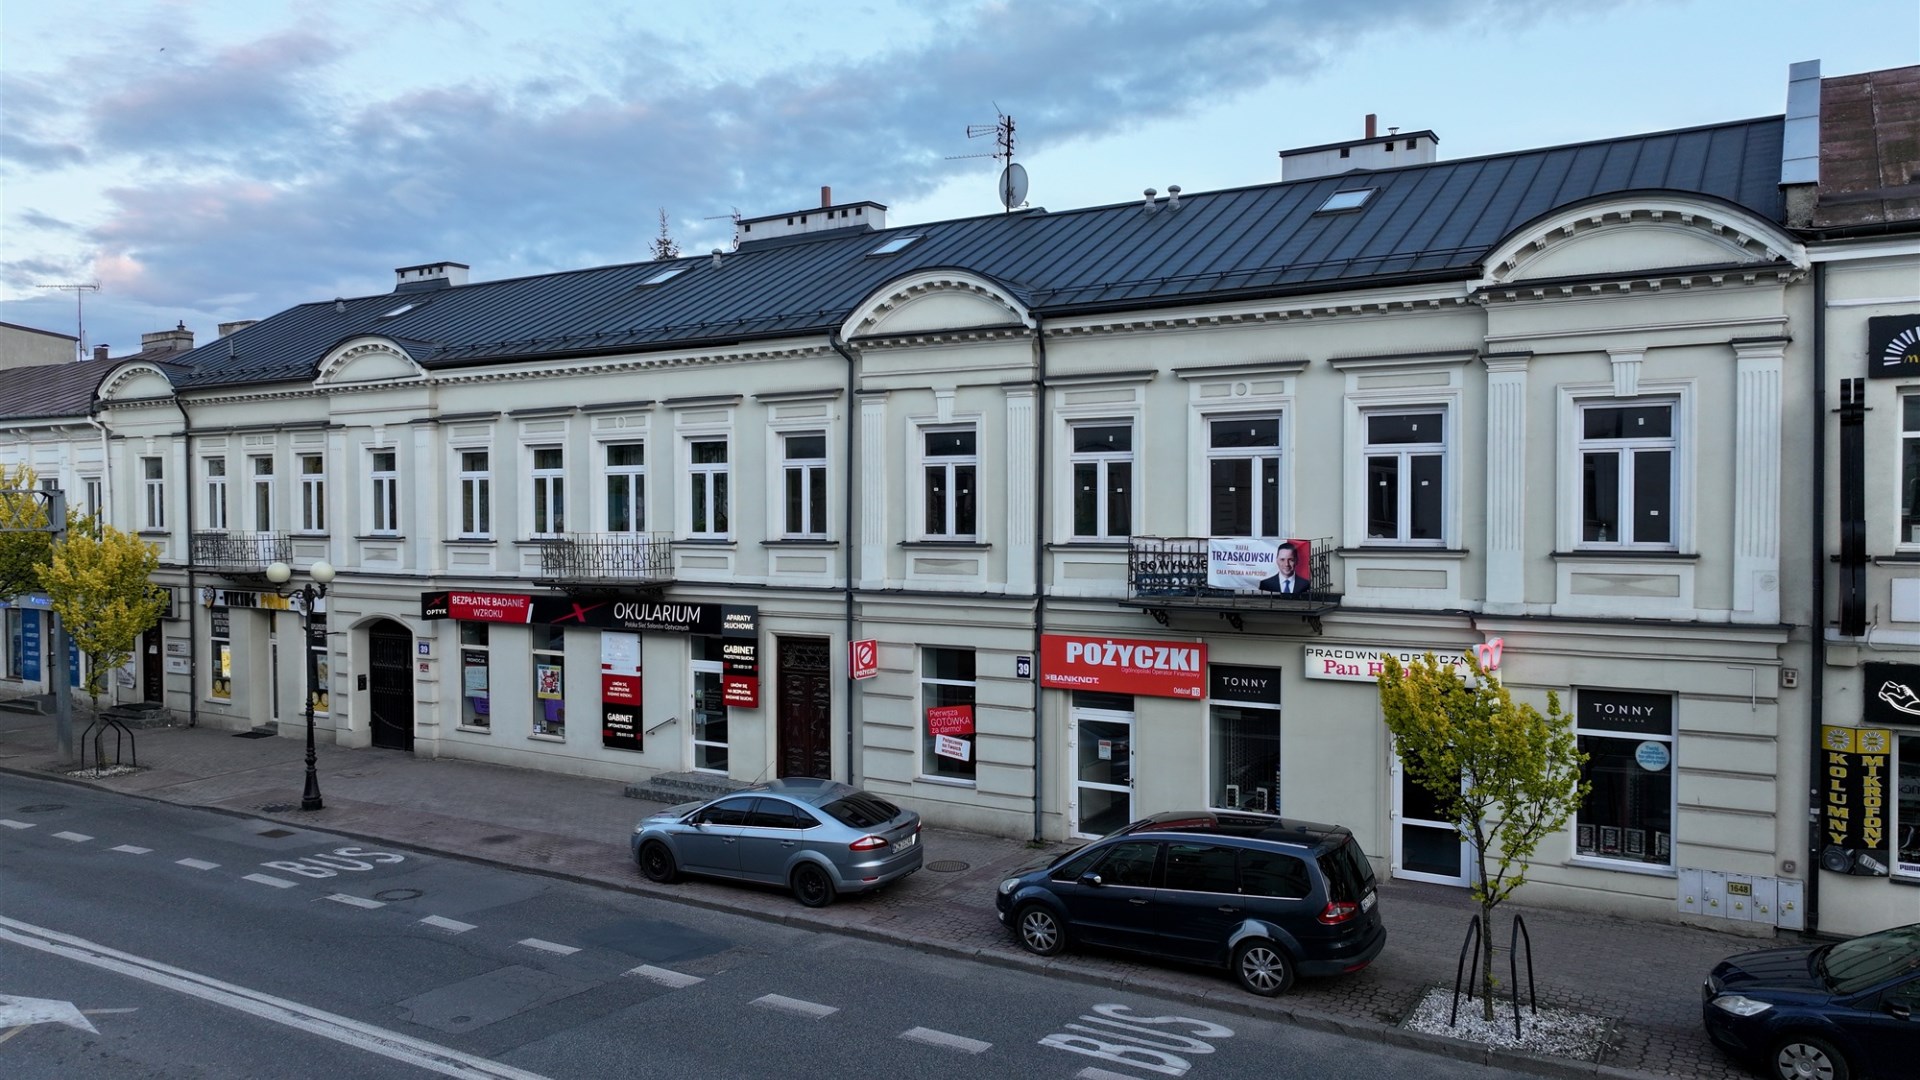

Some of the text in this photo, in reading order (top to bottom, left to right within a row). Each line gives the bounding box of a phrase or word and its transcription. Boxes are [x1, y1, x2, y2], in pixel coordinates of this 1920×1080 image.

[1212, 550, 1274, 563] TRZASKOWSKI
[1227, 569, 1244, 577] POLSKA
[452, 595, 524, 608] BEZPŁATNE BADANIE
[426, 608, 447, 616] OPTYK
[473, 608, 503, 618] WZROKU
[614, 602, 701, 624] OKULARIUM
[726, 614, 751, 622] APARATY
[723, 622, 754, 630] SŁUCHOWE
[420, 645, 428, 653] 39
[723, 644, 755, 655] GABINET
[1066, 640, 1200, 672] POŻYCZKI
[1018, 663, 1029, 675] 39
[1121, 667, 1200, 679] Ogólnopolski Operator Finansowy
[1323, 659, 1360, 676] Pan
[1222, 676, 1268, 688] TONNY
[1173, 687, 1200, 696] Oddział 16
[930, 709, 958, 717] Pierwsza
[1593, 703, 1654, 716] TONNY
[607, 712, 633, 723] GABINET
[930, 716, 971, 727] GOTÓWKA
[940, 725, 962, 733] darmo!
[1827, 752, 1849, 845] KOLUMNY
[1861, 755, 1884, 849] MIKROFONY
[260, 846, 405, 879] BUS
[1730, 884, 1748, 893] 1648
[1037, 1003, 1235, 1077] BUS
